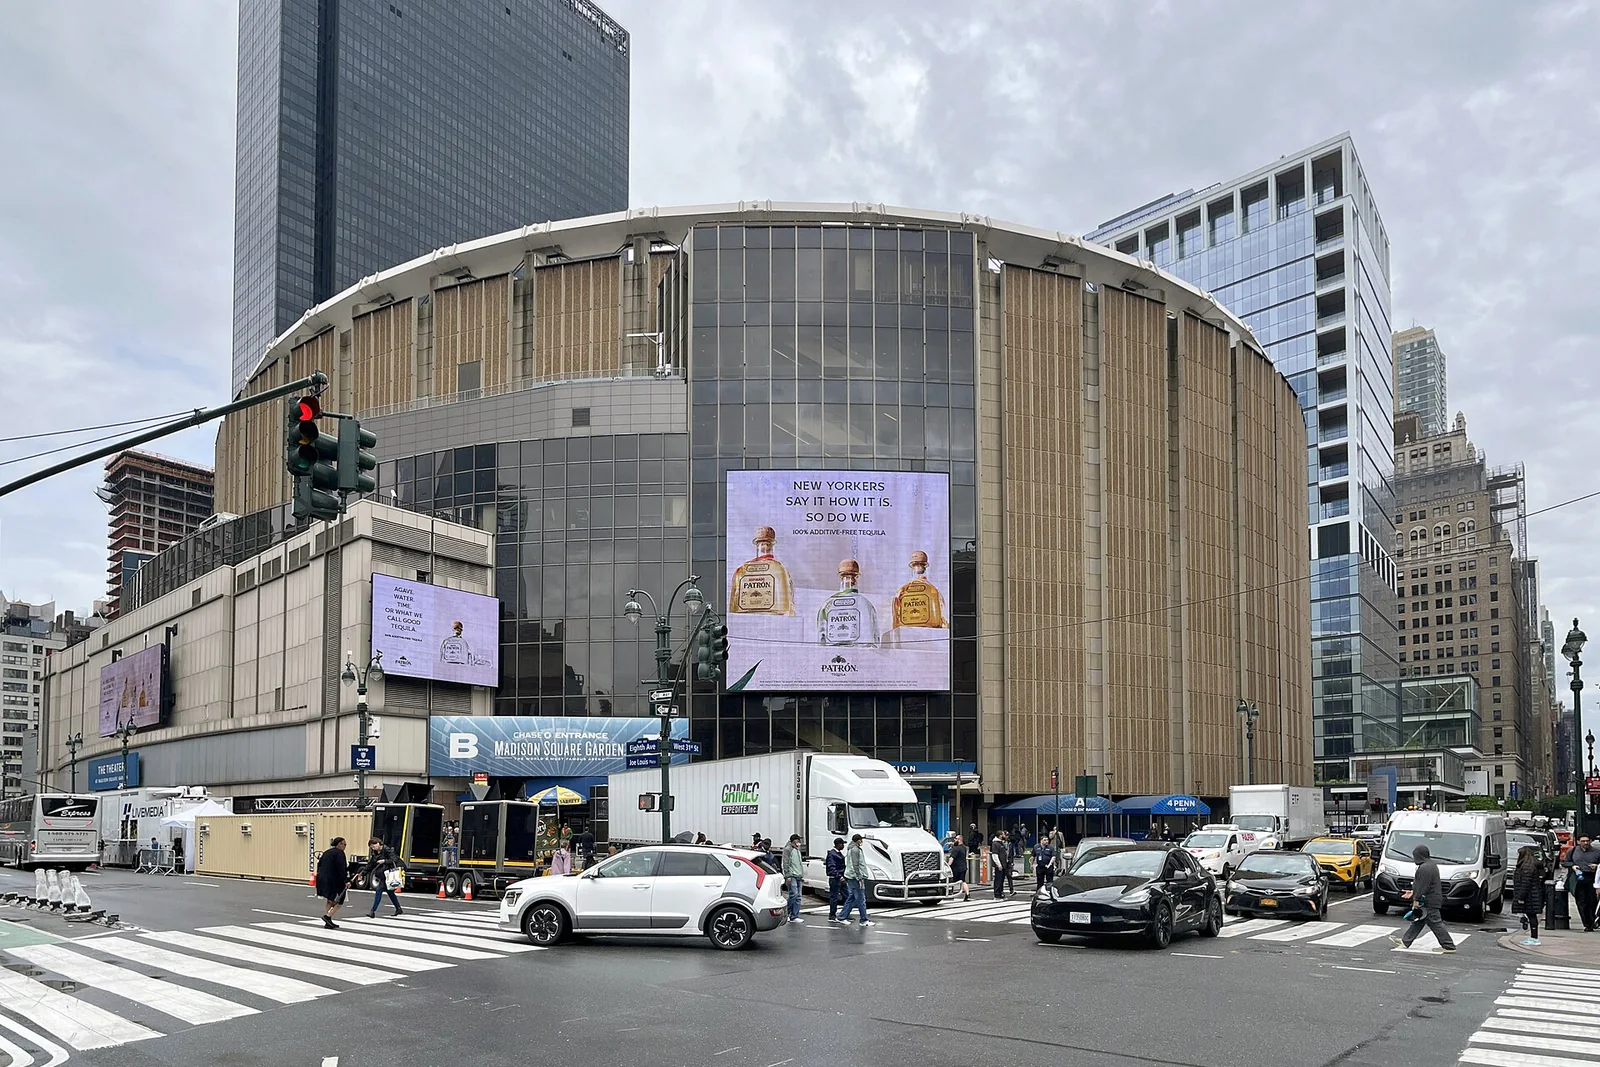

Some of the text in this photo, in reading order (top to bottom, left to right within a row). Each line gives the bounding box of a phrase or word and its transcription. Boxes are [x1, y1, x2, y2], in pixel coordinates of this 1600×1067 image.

[793, 481, 885, 491] NEW YORKERS
[786, 496, 893, 507] SAY IT HOW IT IS.
[806, 512, 873, 523] SO DO WE.
[743, 581, 771, 589] PATRÓN
[394, 586, 414, 595] AGAVE.
[393, 594, 415, 602] WATER.
[395, 608, 412, 617] WHAT
[387, 615, 402, 623] CALL
[391, 623, 417, 632] TEQUILA.
[1531, 647, 1540, 717] GIMBELS
[513, 731, 542, 739] CHASE
[449, 732, 478, 759] B
[494, 740, 540, 756] MADISON
[543, 740, 582, 756] SQUARE
[629, 744, 645, 753] Eighth
[97, 764, 106, 775] THE
[721, 781, 759, 803] GRMEC
[1075, 798, 1085, 807] A
[1167, 799, 1173, 807] 4
[60, 809, 91, 818] Express
